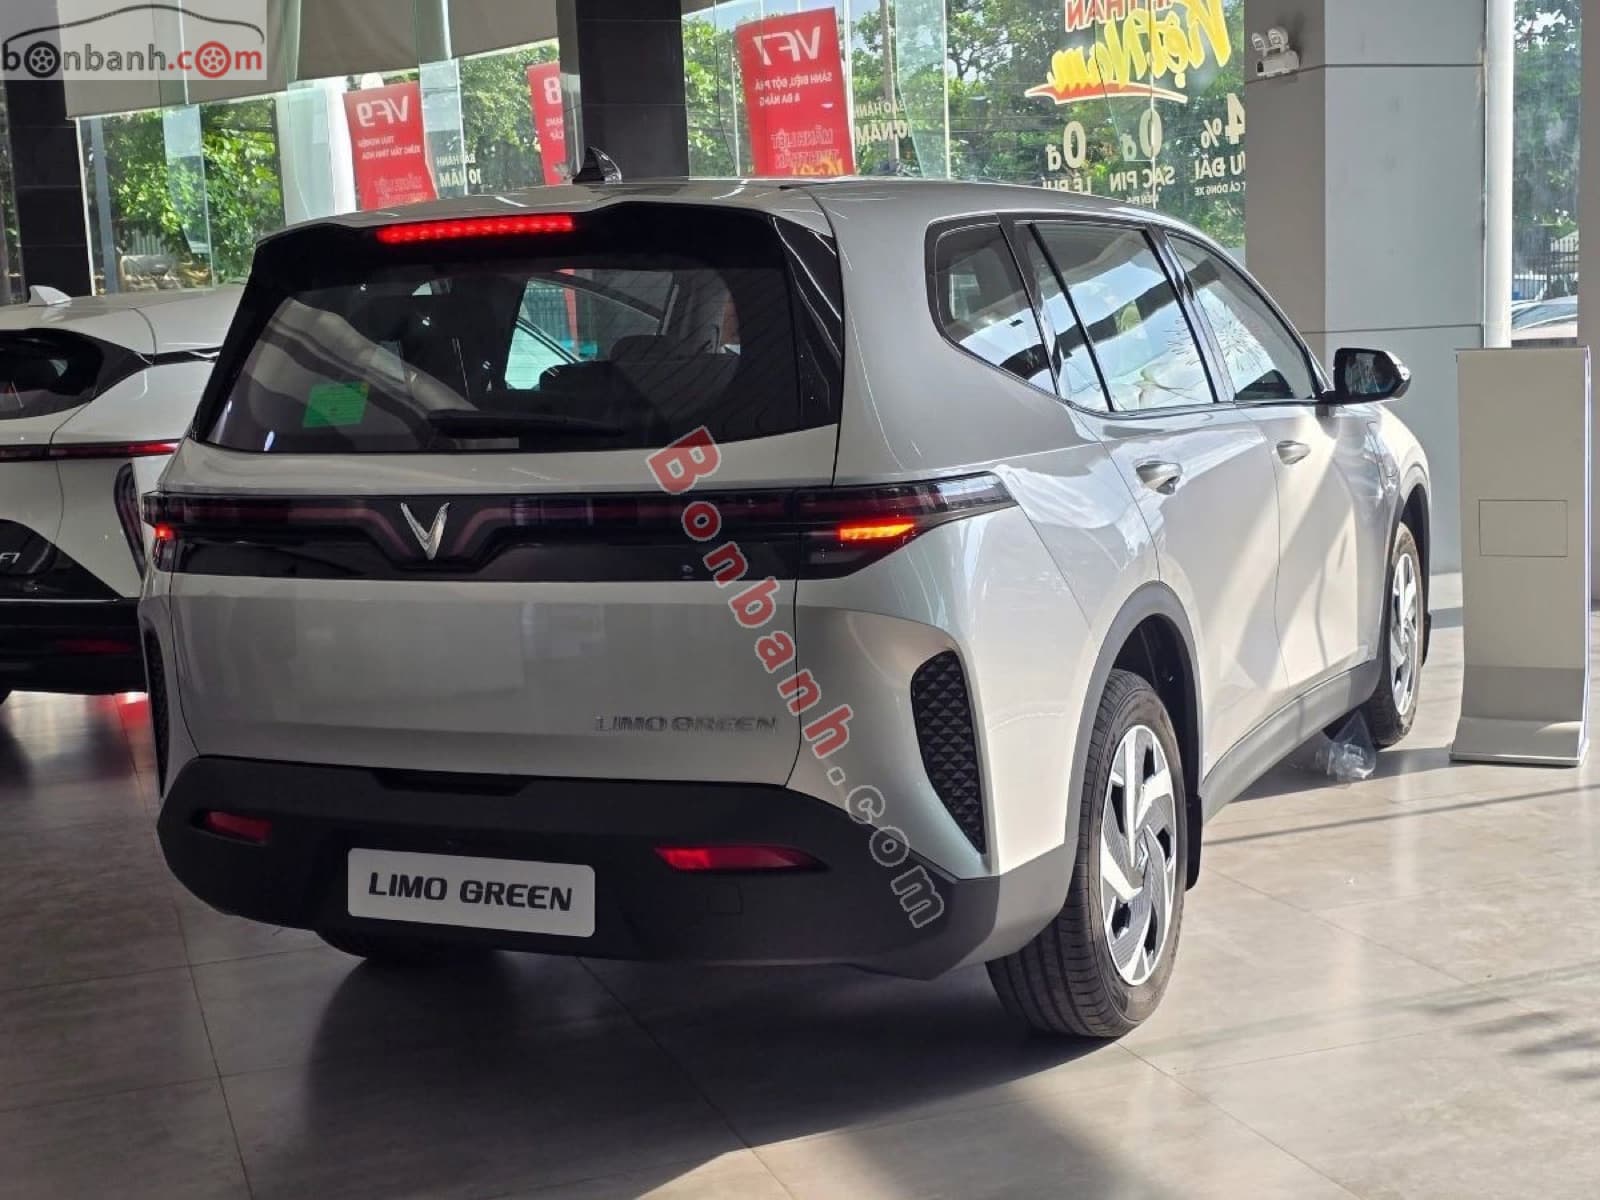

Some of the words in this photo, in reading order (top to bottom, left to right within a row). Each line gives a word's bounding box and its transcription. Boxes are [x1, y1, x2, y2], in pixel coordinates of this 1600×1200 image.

[595, 716, 667, 731] LIMO
[671, 716, 776, 731] GREEN
[368, 872, 447, 900] LIMO
[459, 879, 573, 911] GREEN
